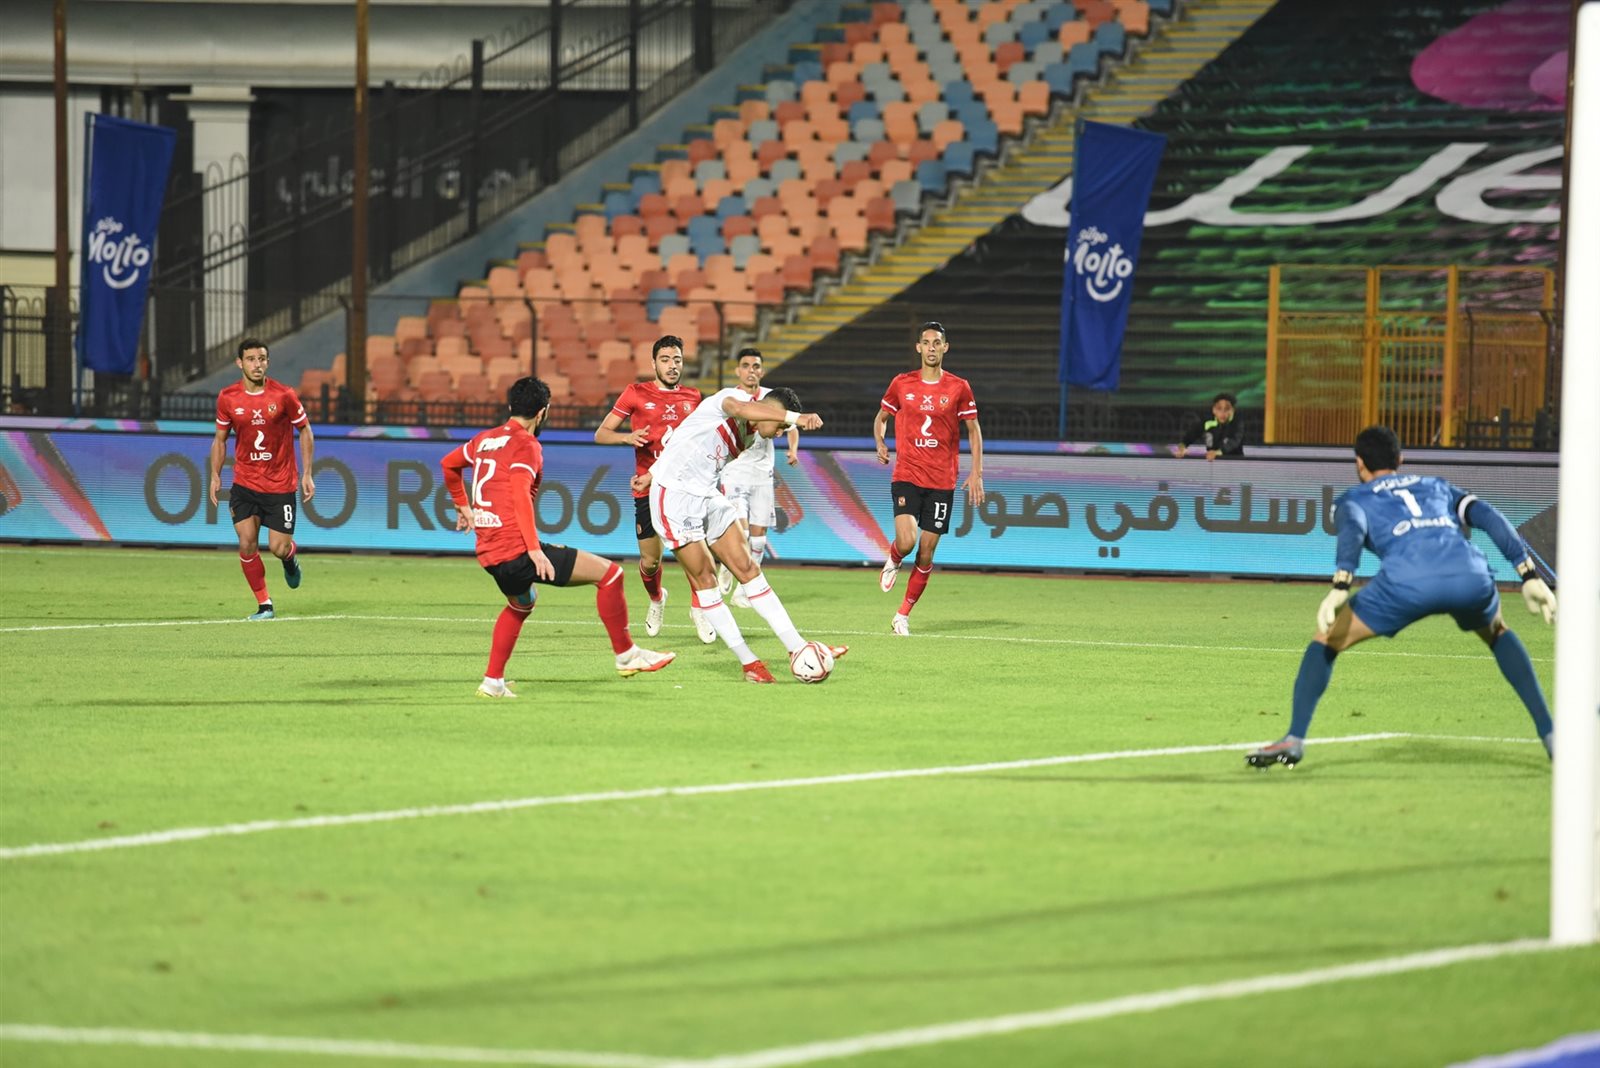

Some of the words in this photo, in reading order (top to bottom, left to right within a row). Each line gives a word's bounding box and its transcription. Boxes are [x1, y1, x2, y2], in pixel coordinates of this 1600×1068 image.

[472, 457, 497, 507] 12
[283, 504, 293, 522] 8
[934, 501, 948, 521] 13
[955, 491, 1070, 539] صور
[1085, 481, 1180, 558] في
[1393, 488, 1423, 518] 1
